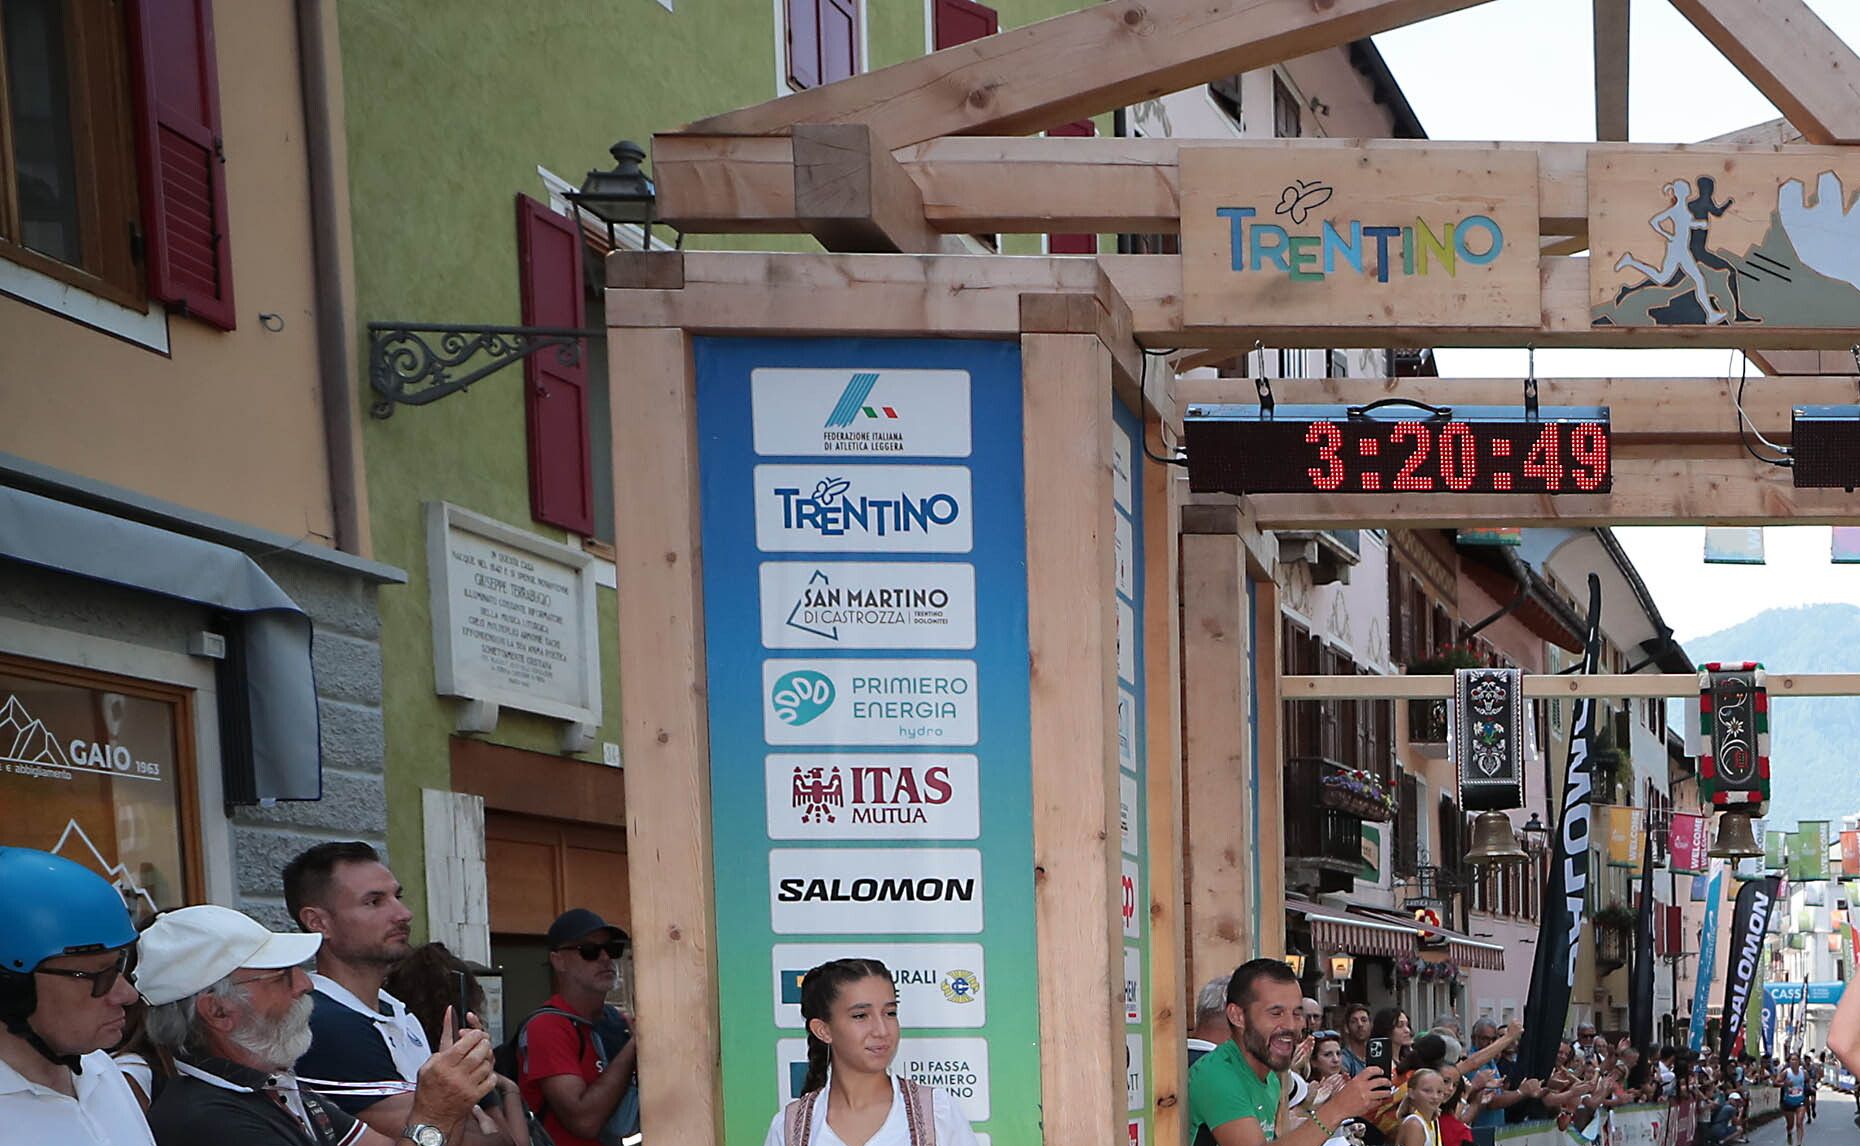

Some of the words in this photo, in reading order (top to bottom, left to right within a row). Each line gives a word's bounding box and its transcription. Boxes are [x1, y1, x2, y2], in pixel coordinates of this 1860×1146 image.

[1215, 206, 1504, 285] TRENTINO
[823, 432, 869, 441] FEDERAZIONE
[872, 432, 903, 441] ITALIANA
[824, 442, 832, 451] DI
[835, 442, 868, 451] ATLETICA
[871, 442, 904, 451] LEGGERA
[1306, 421, 1608, 491] 3:20:49
[774, 488, 959, 537] TRENTINO
[804, 588, 840, 608] SAN
[847, 588, 949, 608] MARTINO
[822, 610, 906, 625] CASTROZZA
[852, 677, 969, 695] PRIMIERO
[853, 702, 957, 719] ENERGIA
[899, 726, 944, 739] hydro
[70, 739, 131, 771] GAIO
[136, 761, 160, 775] 1963
[851, 766, 953, 805] ITAS
[852, 807, 927, 824] MUTUA
[1691, 817, 1703, 869] WELCOME
[777, 878, 975, 902] SALOMON
[910, 1061, 924, 1072] DI
[928, 1061, 970, 1072] FASSA
[911, 1074, 977, 1085] PRIMIERO
